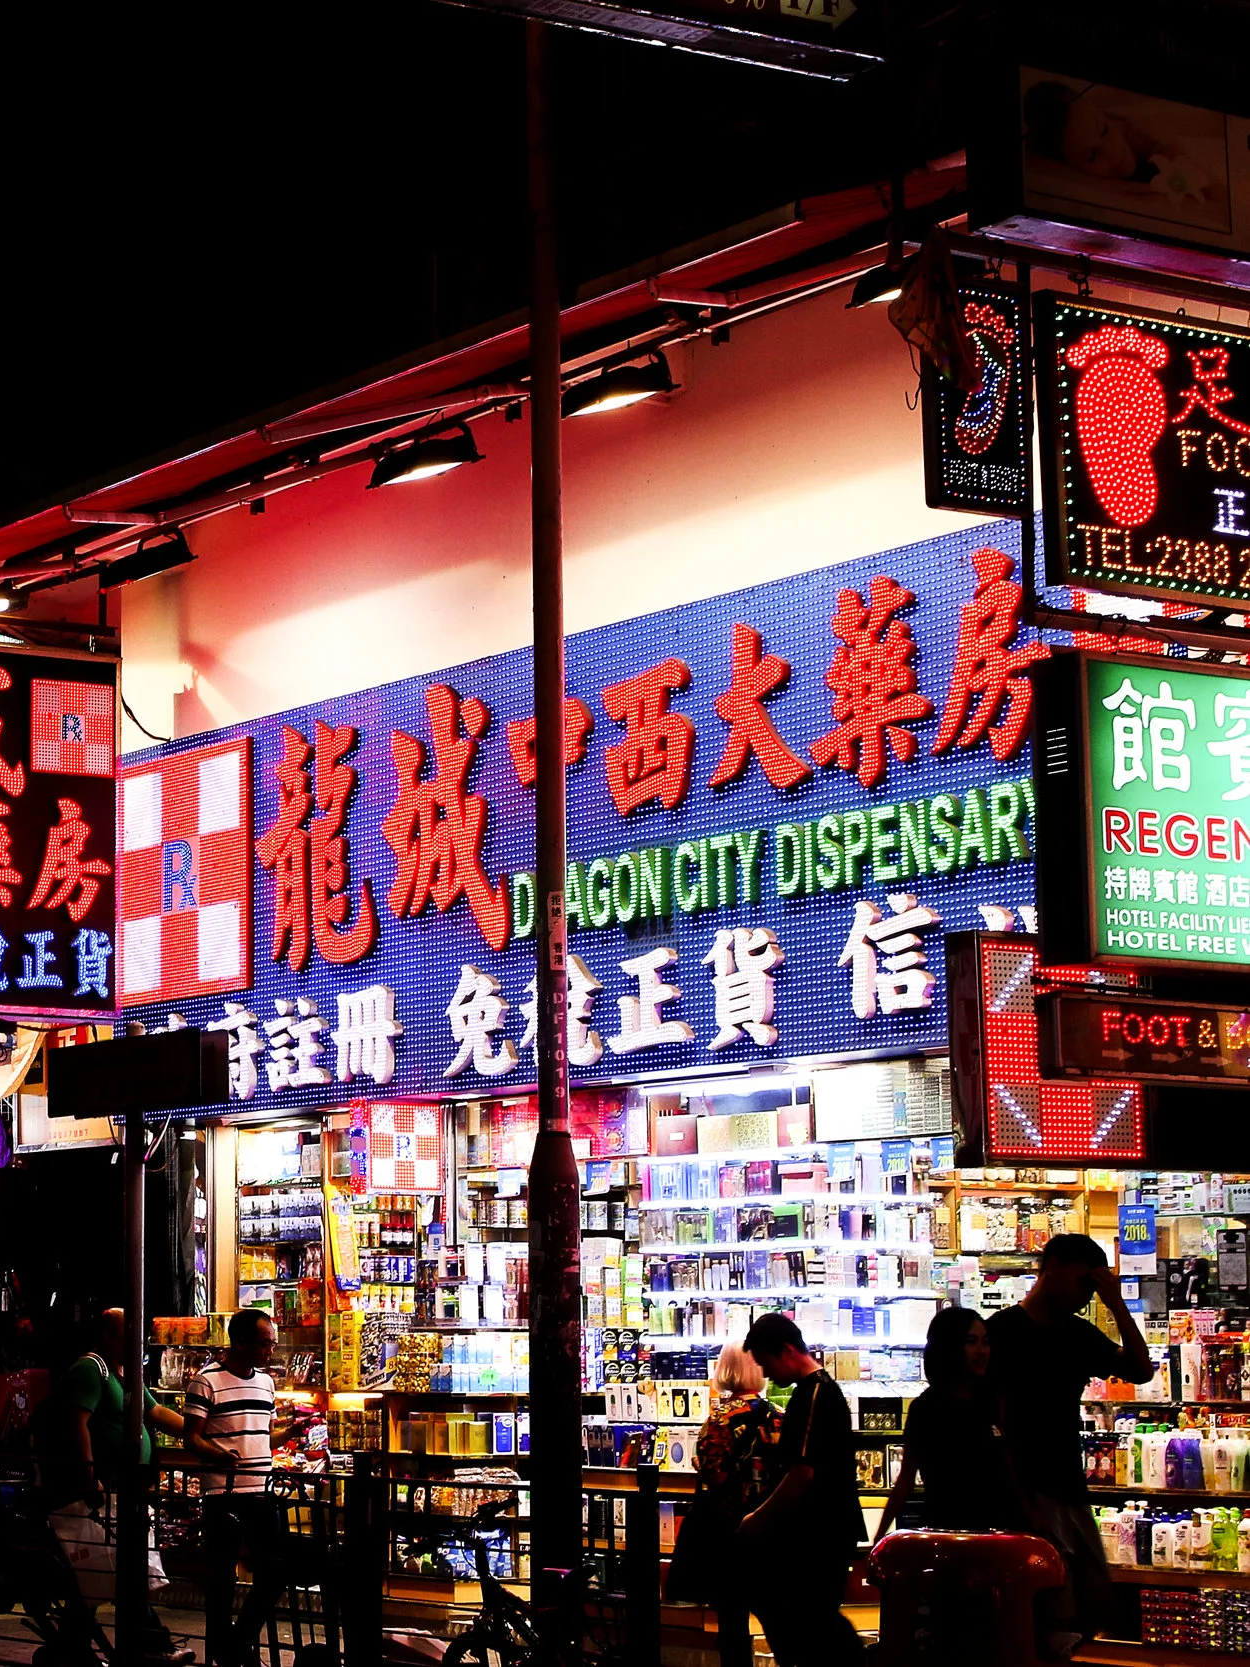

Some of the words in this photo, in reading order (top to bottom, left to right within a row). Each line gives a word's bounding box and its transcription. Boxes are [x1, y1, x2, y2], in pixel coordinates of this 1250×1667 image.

[1171, 346, 1250, 436] 足
[513, 848, 668, 939] DAGON
[674, 828, 763, 911] CITY
[1104, 865, 1199, 905] 持牌賓館
[1106, 908, 1158, 929] HOTEL
[1159, 911, 1225, 934] FACILITY
[1107, 930, 1182, 952] HOTEL
[1186, 935, 1237, 955] FREE
[1102, 1011, 1191, 1048] FOOT
[1198, 1019, 1218, 1048] &
[1124, 1225, 1147, 1241] 2018
